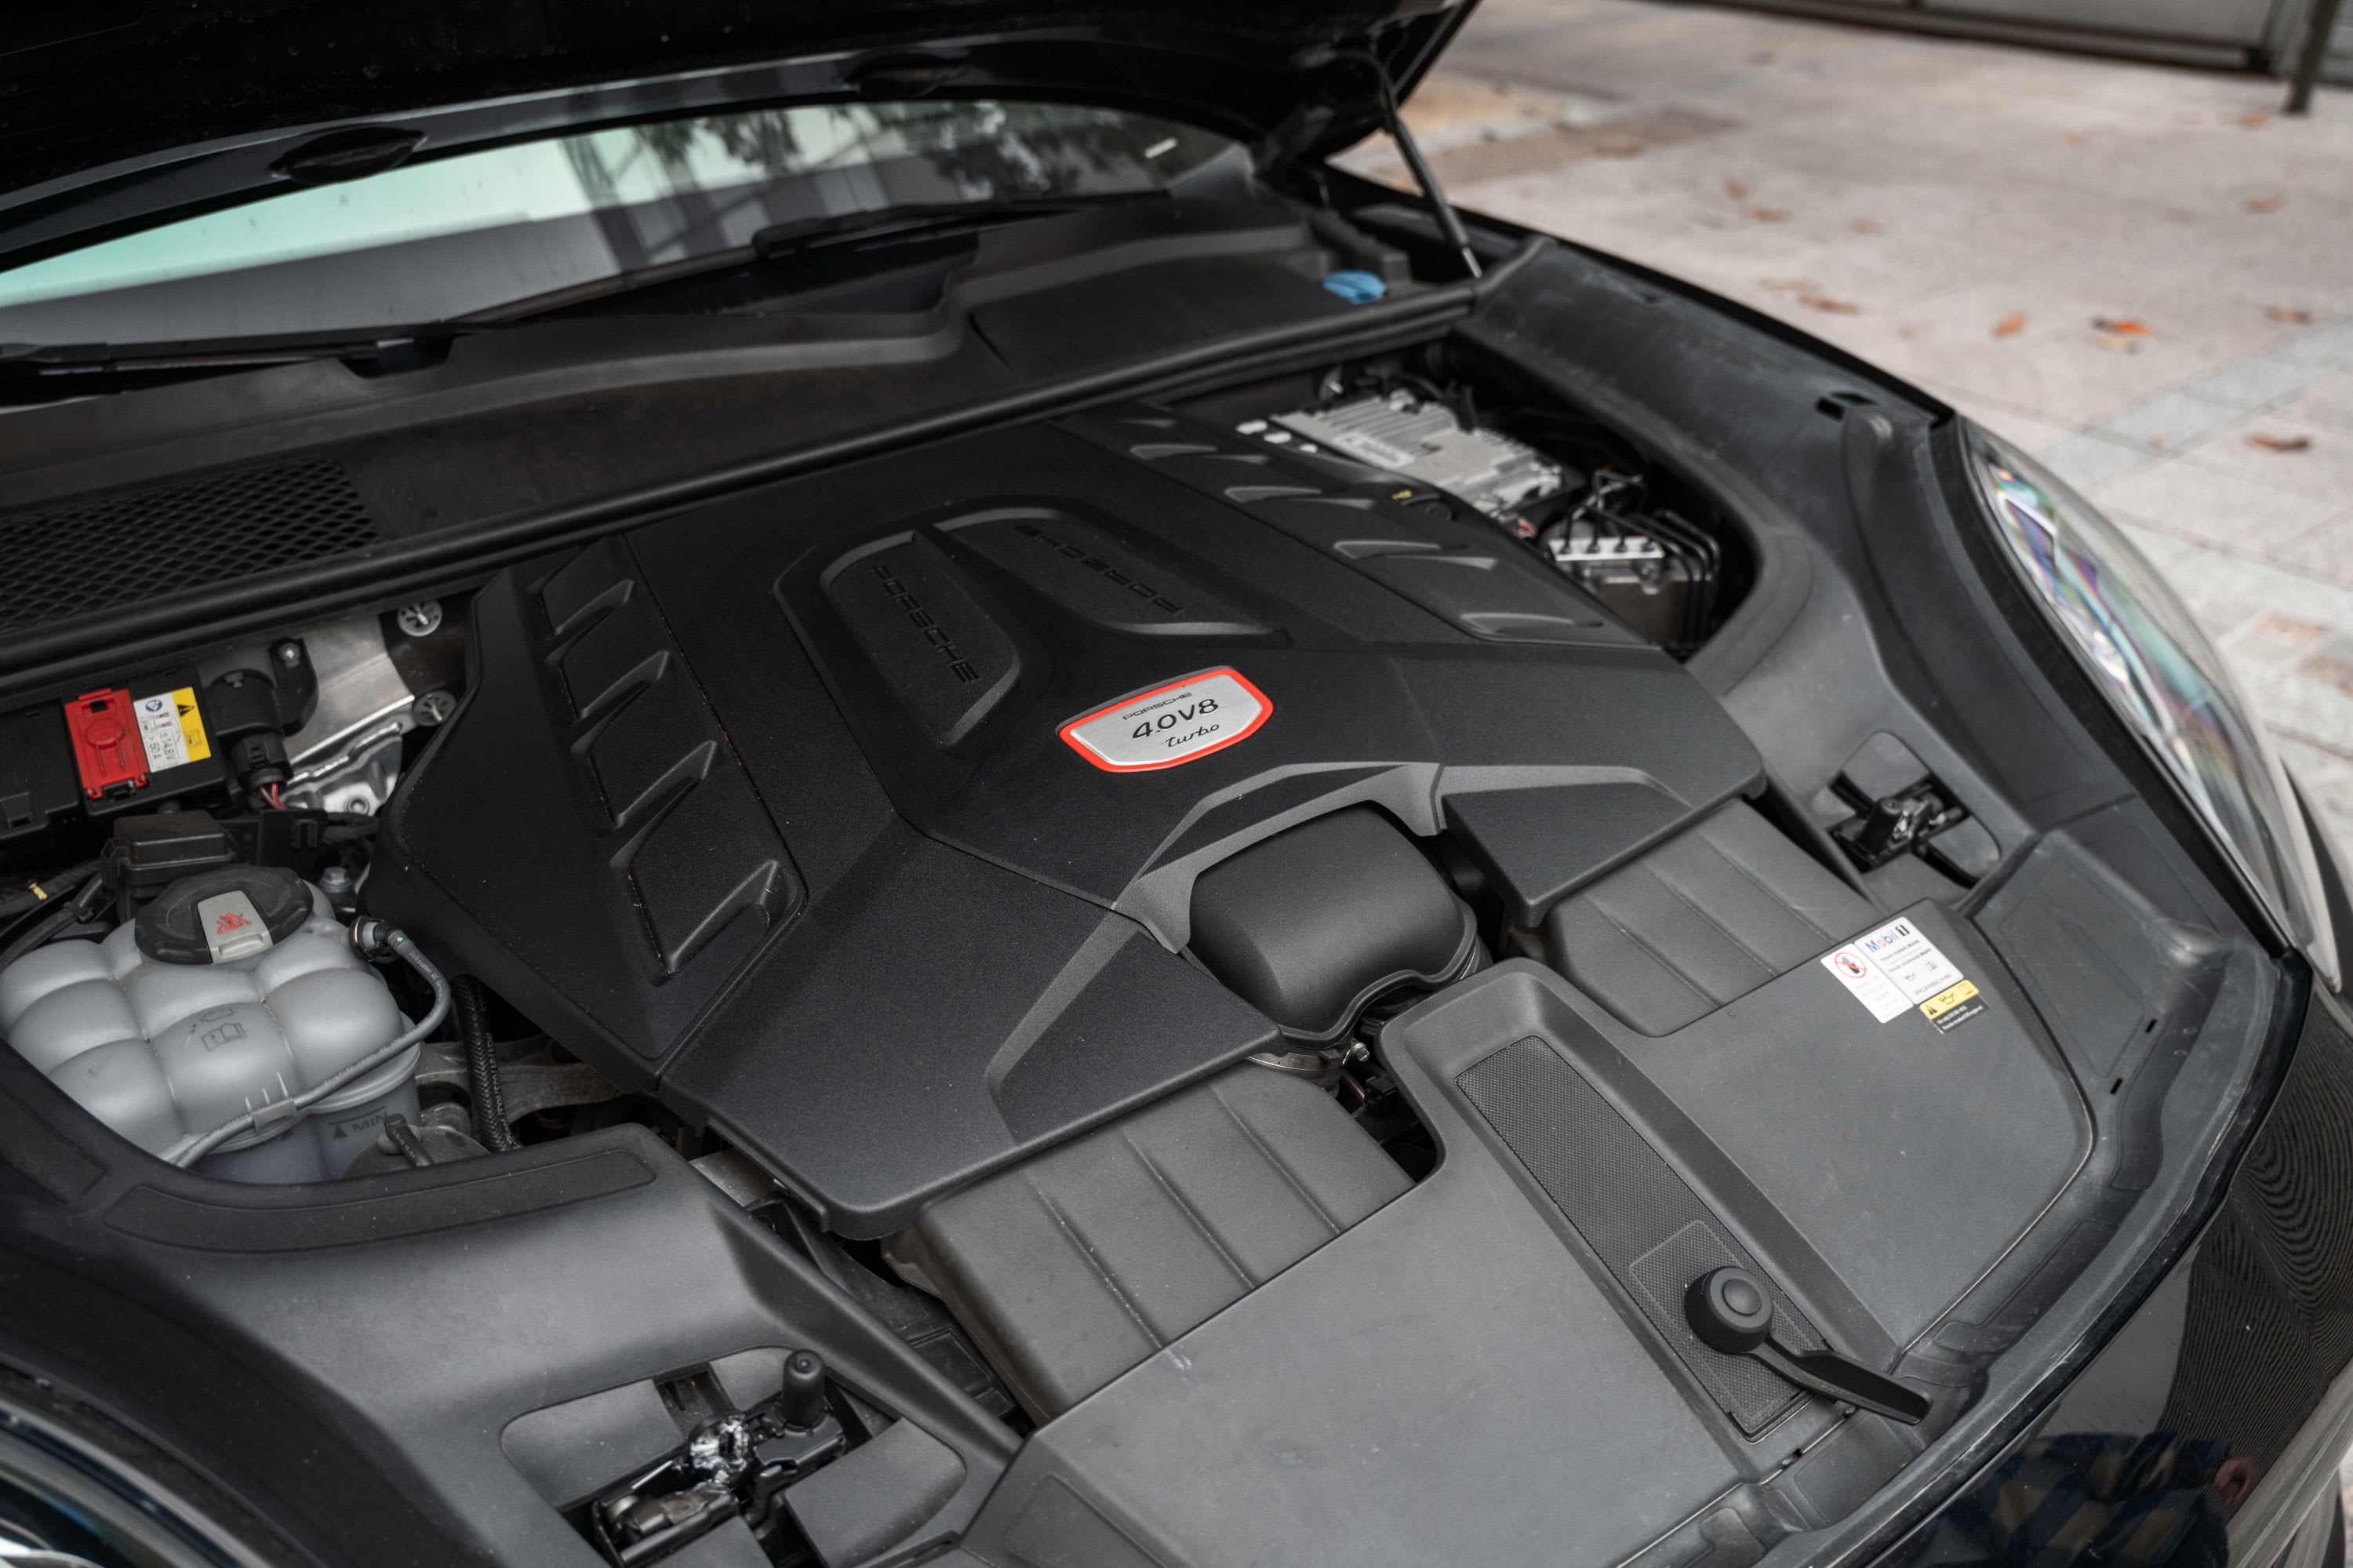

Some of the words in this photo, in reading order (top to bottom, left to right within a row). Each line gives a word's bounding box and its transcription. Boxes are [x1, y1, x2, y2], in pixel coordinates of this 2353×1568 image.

[873, 565, 980, 683] PORSCHE
[1122, 692, 1193, 721] PORSCHE
[1165, 723, 1220, 748] turbo
[1864, 930, 1900, 952] Mobil
[352, 1111, 388, 1133] MIN
